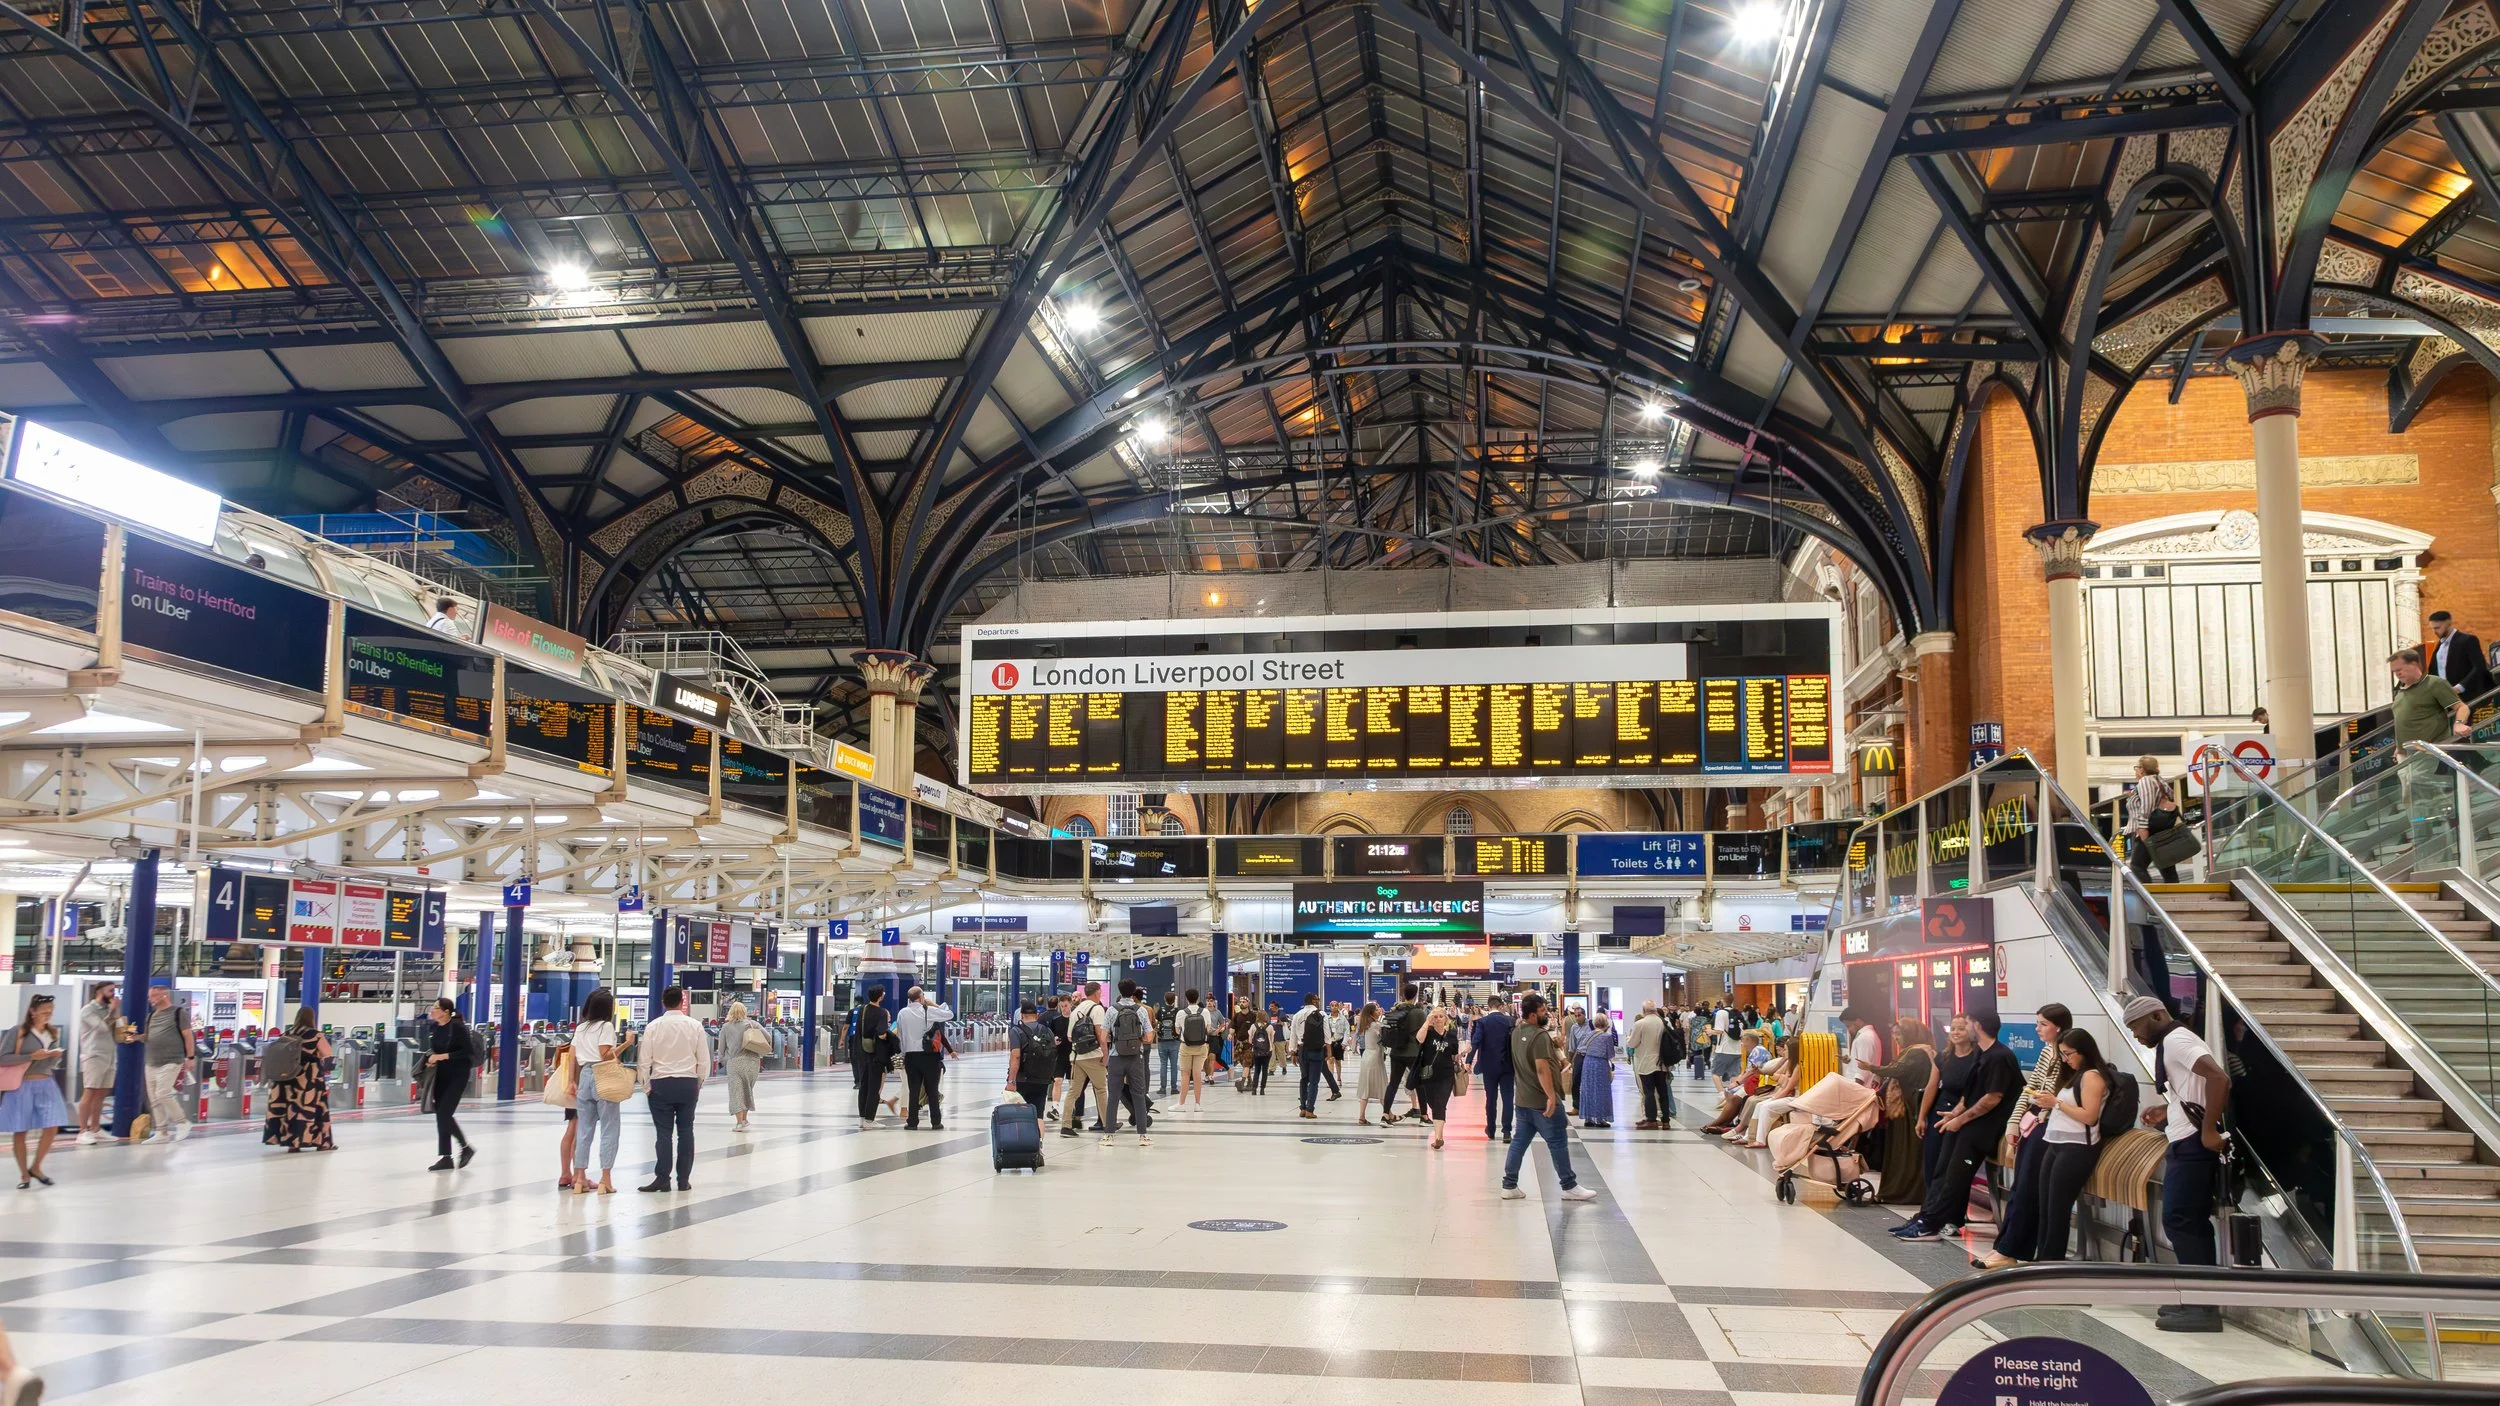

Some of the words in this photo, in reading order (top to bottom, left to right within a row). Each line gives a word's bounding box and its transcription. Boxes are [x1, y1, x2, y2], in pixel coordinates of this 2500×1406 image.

[134, 569, 175, 595] Trains
[180, 585, 194, 600] to
[198, 589, 255, 620] Hertford
[131, 595, 150, 610] on
[155, 597, 191, 620] Uber
[978, 628, 1019, 636] Departures
[494, 619, 514, 640] Isle
[517, 630, 531, 645] of
[532, 634, 575, 663] Flowers
[352, 637, 381, 658] Trains
[384, 648, 394, 662] to
[397, 652, 443, 677] Shenfield
[349, 659, 363, 671] on
[366, 660, 392, 679] Uber
[1032, 664, 1125, 686] London
[1135, 660, 1254, 687] Liverpool
[1263, 659, 1344, 681] Street
[675, 688, 704, 712] LUSH
[646, 734, 653, 742] to
[654, 735, 686, 752] Colchester
[919, 783, 941, 799] supercuts
[1643, 841, 1661, 850] Lift
[1750, 845, 1762, 854] Ely
[1135, 850, 1164, 859] mbridge
[1611, 859, 1648, 868] Toilets
[215, 881, 233, 911] 4
[510, 887, 523, 900] 4
[1377, 886, 1398, 899] Sage
[428, 901, 440, 927] 5
[1298, 900, 1376, 914] AUTHENTIC
[1378, 900, 1479, 914] INTELLIGENCE
[678, 925, 685, 945] 6
[834, 924, 842, 935] 6
[887, 931, 894, 942] 7
[770, 933, 776, 952] 7
[1846, 930, 1868, 954] NatWest
[1055, 951, 1061, 960] 8
[1081, 954, 1086, 962] 9
[2014, 1036, 2028, 1048] Follow
[2028, 1040, 2034, 1048] us
[1994, 1356, 2038, 1370] Please
[2042, 1359, 2081, 1372] stand
[1995, 1375, 2012, 1385] on
[2016, 1374, 2040, 1386] the
[2044, 1375, 2078, 1390] right
